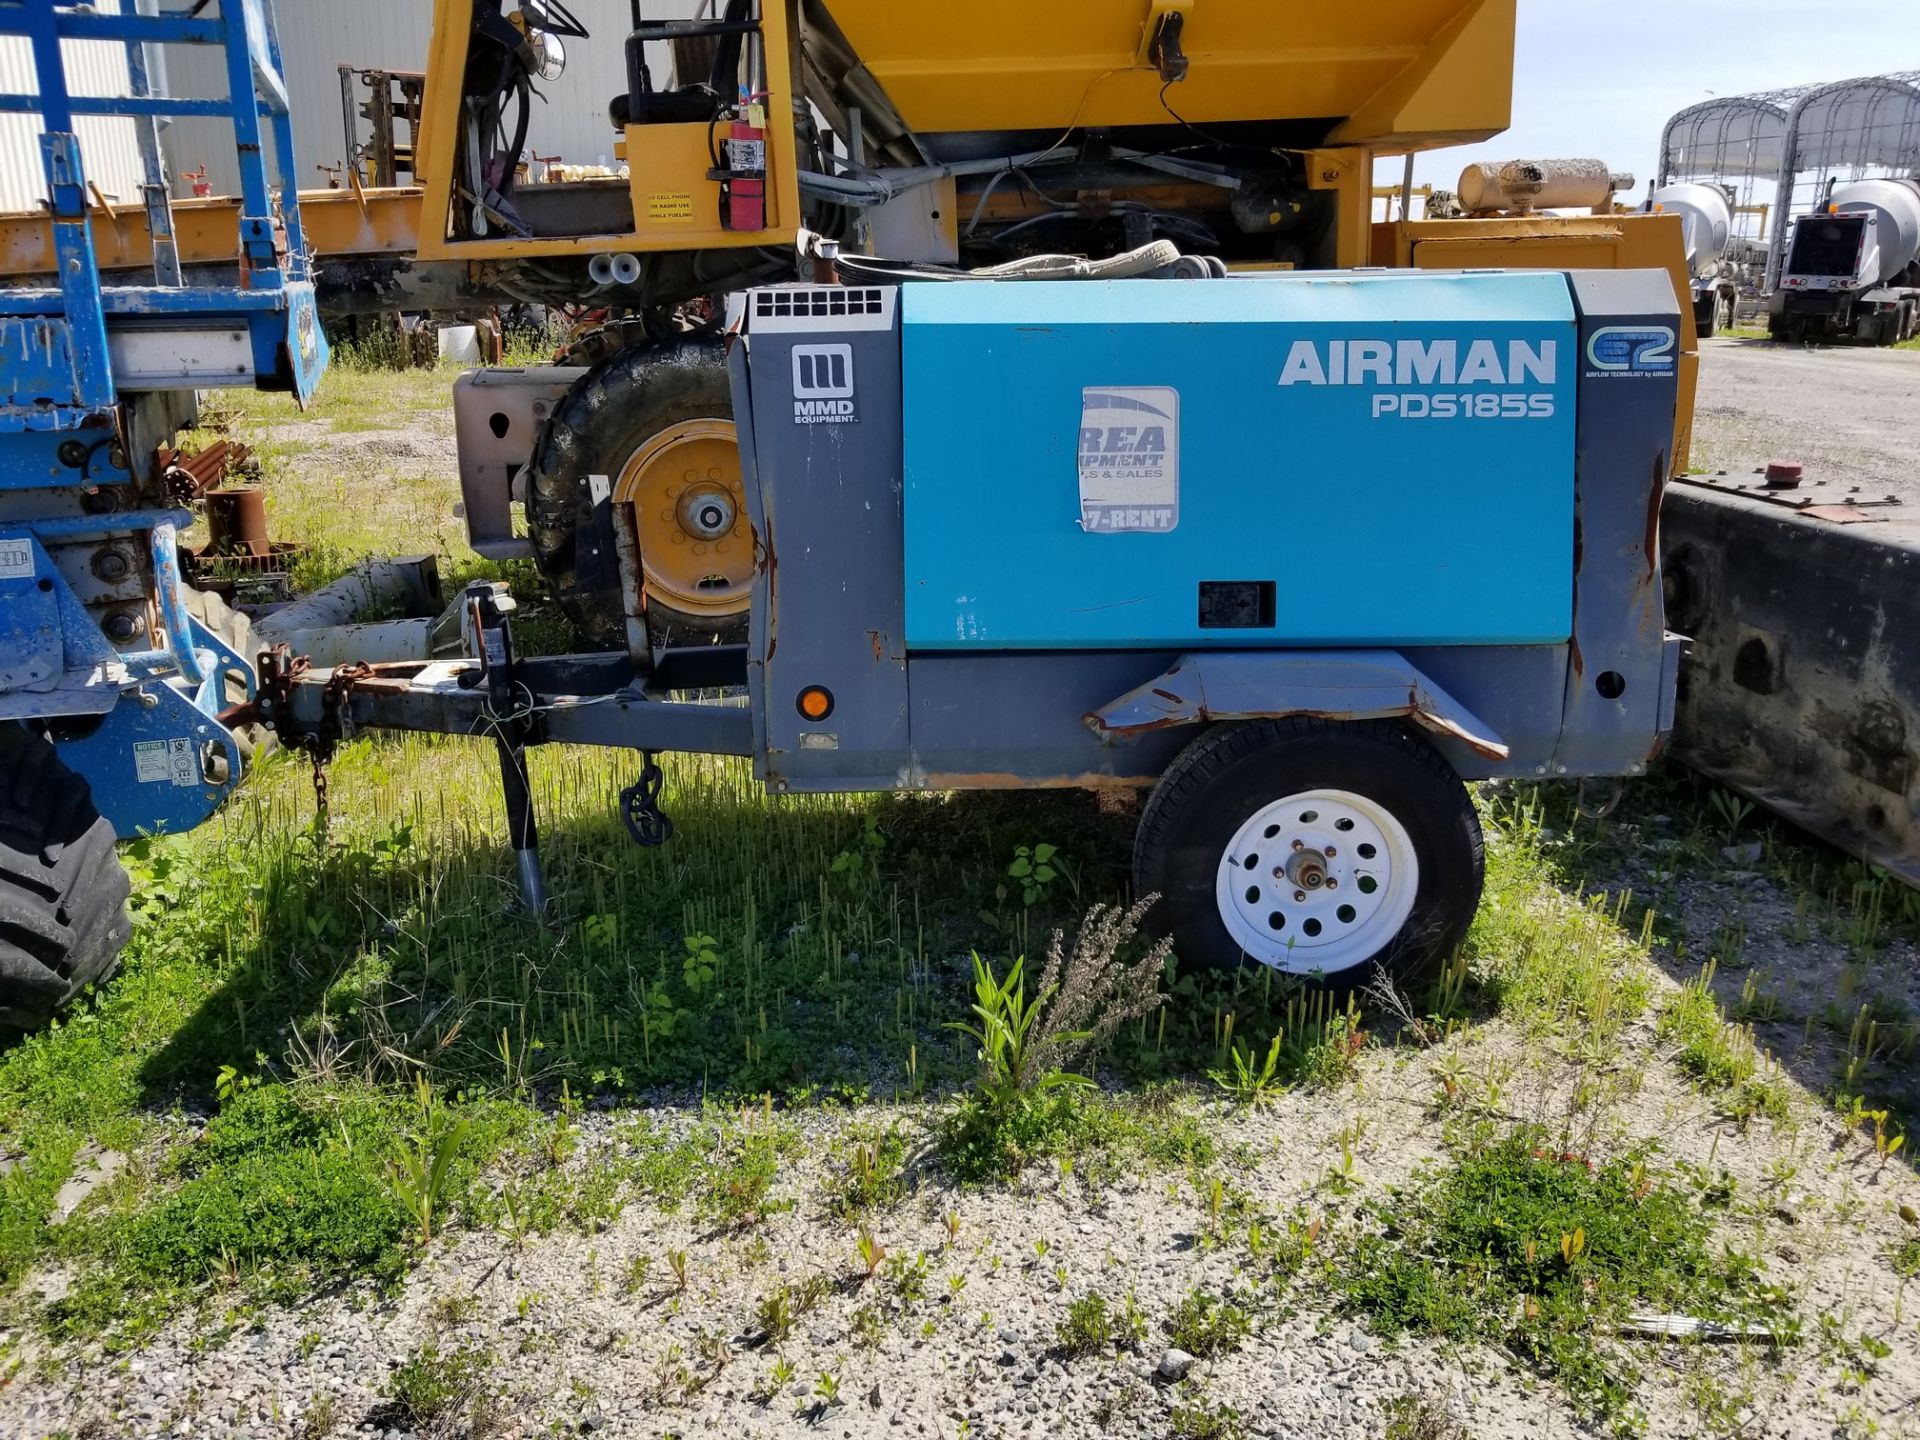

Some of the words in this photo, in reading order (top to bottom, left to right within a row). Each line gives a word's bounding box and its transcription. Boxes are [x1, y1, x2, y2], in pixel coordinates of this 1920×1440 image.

[1278, 340, 1557, 386] AIRMAN
[793, 401, 854, 416] MMD
[1372, 393, 1555, 418] PDS185S
[794, 416, 855, 424] EQUIPMENT
[1102, 470, 1113, 479] &
[1116, 470, 1163, 478] SALES
[138, 742, 162, 750] NOTICE
